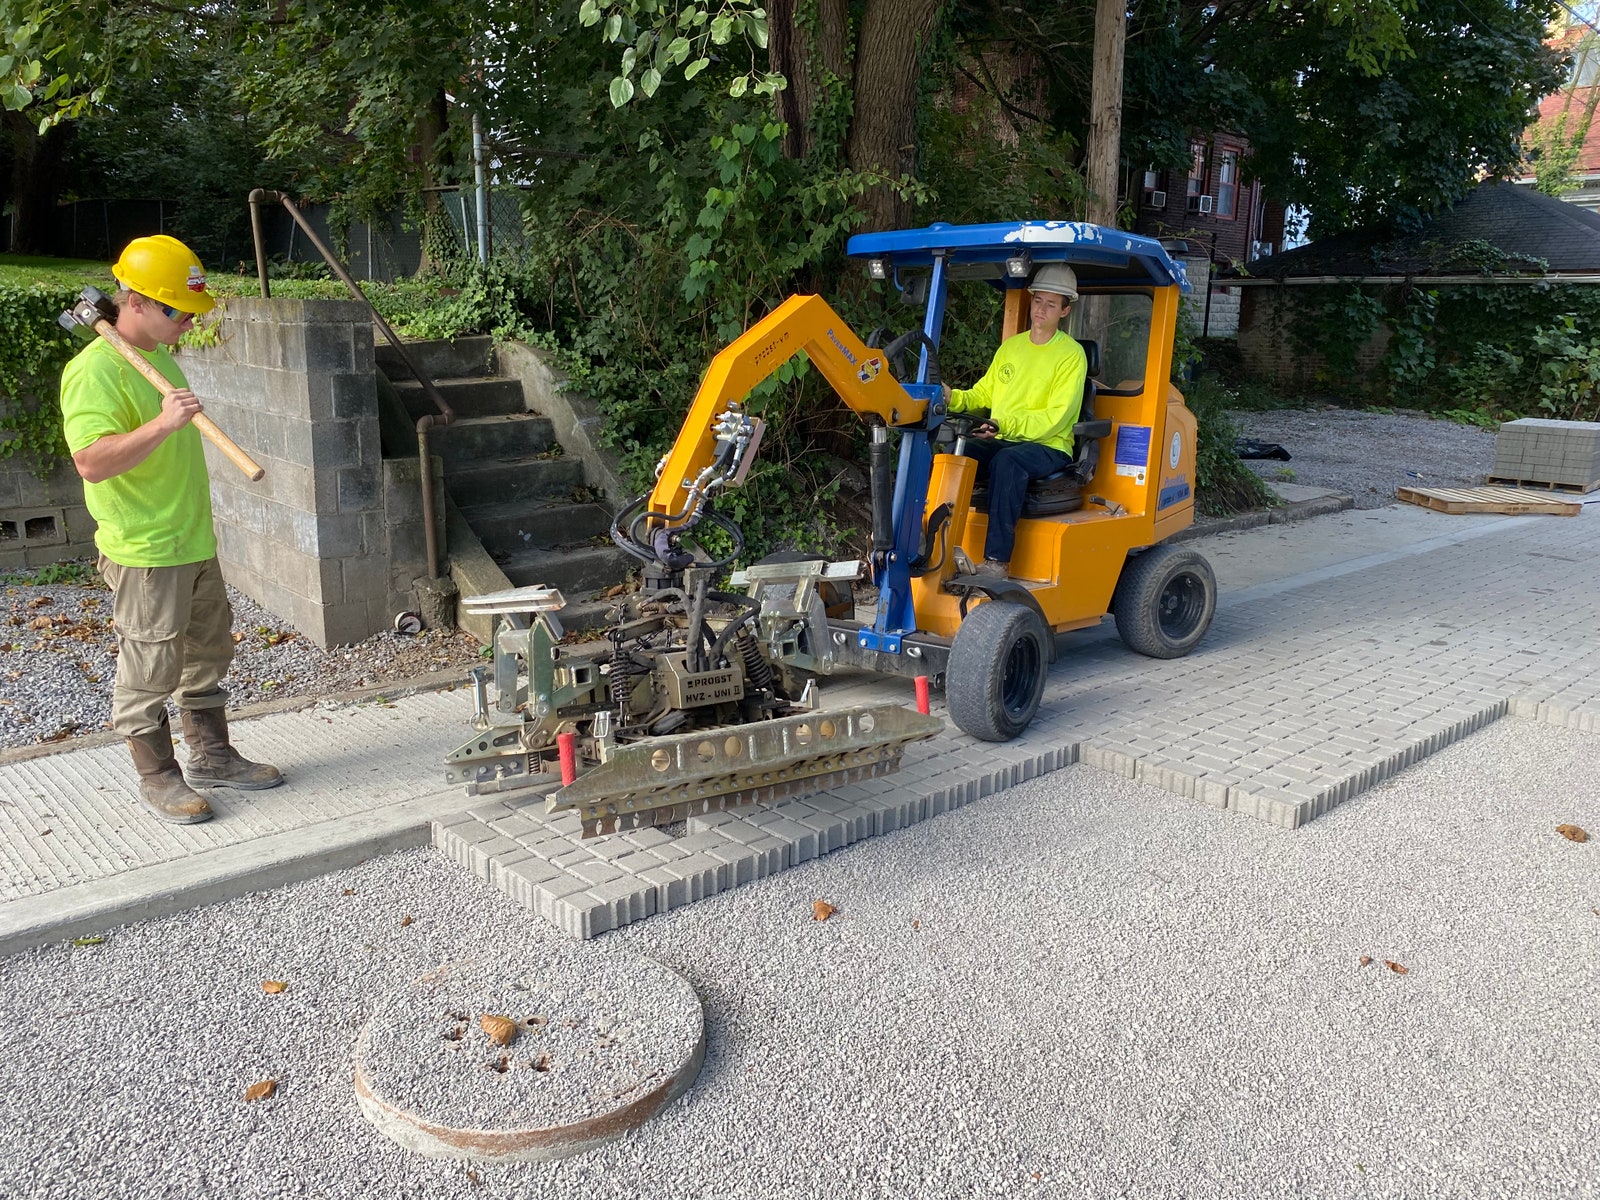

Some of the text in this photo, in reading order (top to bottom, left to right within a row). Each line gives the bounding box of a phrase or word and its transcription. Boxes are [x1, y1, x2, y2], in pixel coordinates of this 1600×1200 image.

[694, 674, 732, 687] PROBST
[686, 692, 705, 703] HVZ
[714, 688, 731, 698] UNI
[733, 685, 741, 695] II
